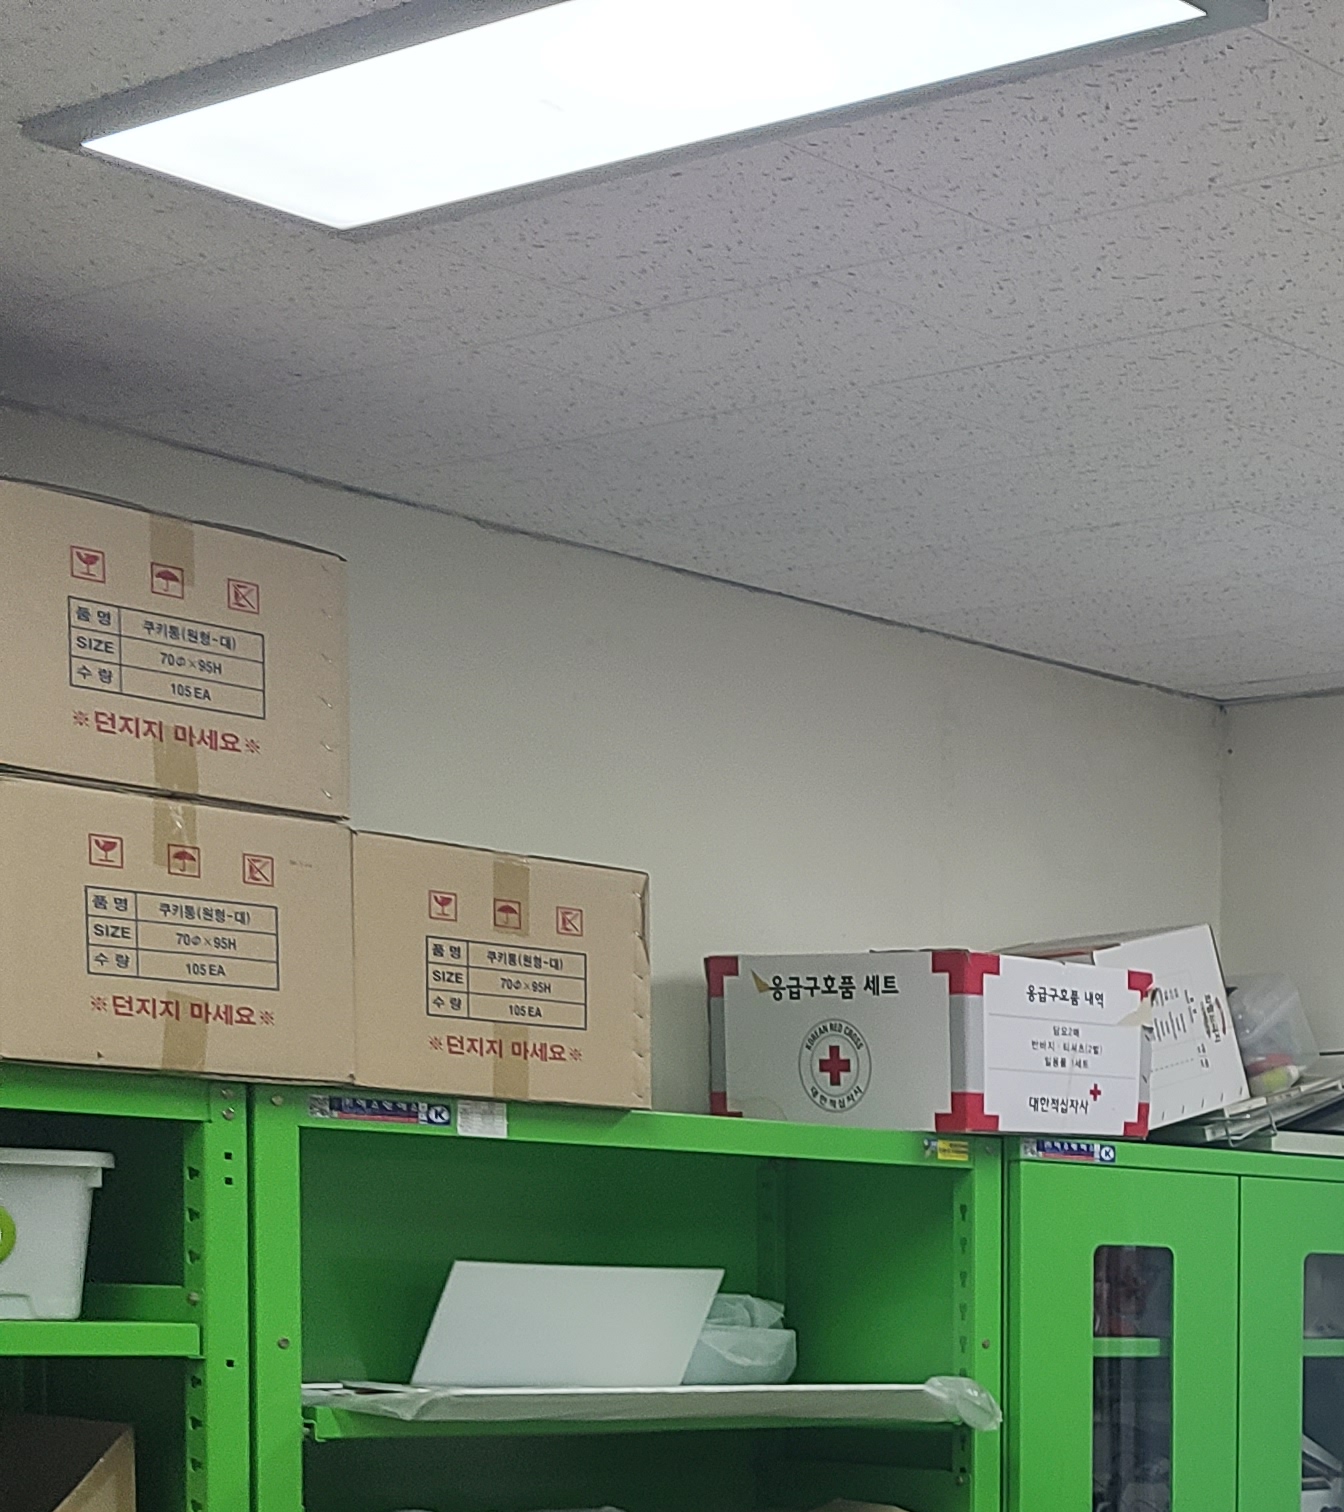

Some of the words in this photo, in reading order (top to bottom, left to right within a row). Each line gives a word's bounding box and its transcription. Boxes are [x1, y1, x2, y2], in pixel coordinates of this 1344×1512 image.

[76, 636, 115, 654] SIZE
[94, 924, 131, 939] SIZE
[432, 970, 464, 984] SIZE
[770, 975, 856, 1001] 응급구호품
[863, 974, 899, 996] 세트
[1026, 984, 1080, 1007] 응급구호품
[1084, 992, 1104, 1008] 내역
[805, 1023, 829, 1051] KOREAN
[829, 1022, 842, 1034] RED
[843, 1025, 863, 1050] CROSS
[1029, 1096, 1089, 1114] 대한적십자사
